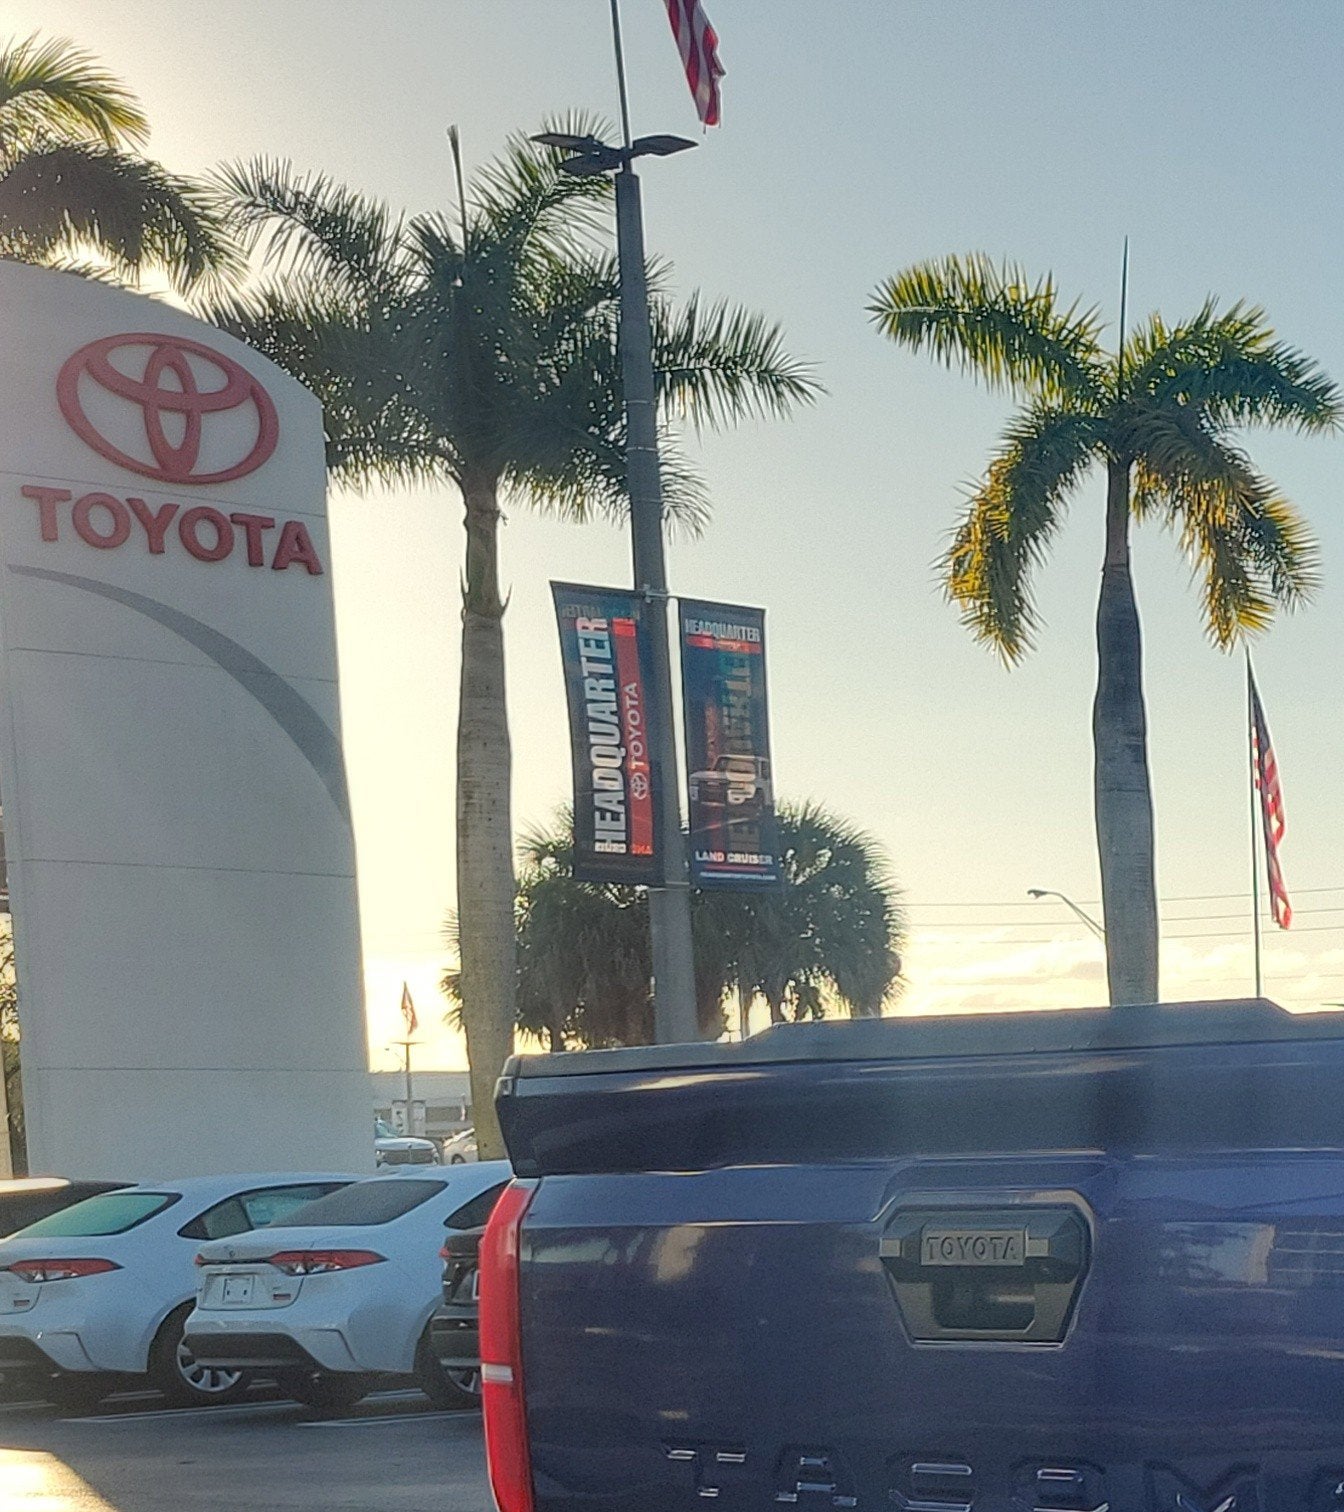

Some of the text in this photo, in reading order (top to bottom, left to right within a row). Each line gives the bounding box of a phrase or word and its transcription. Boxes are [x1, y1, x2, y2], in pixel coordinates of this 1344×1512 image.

[20, 484, 323, 575] TOYOTA
[685, 618, 760, 643] HEADQUARTER
[576, 617, 627, 853] HEADQUARTER
[624, 682, 647, 769] TOYOTA
[695, 850, 774, 866] LAND CRUISER
[926, 1236, 1018, 1261] TOYOTA
